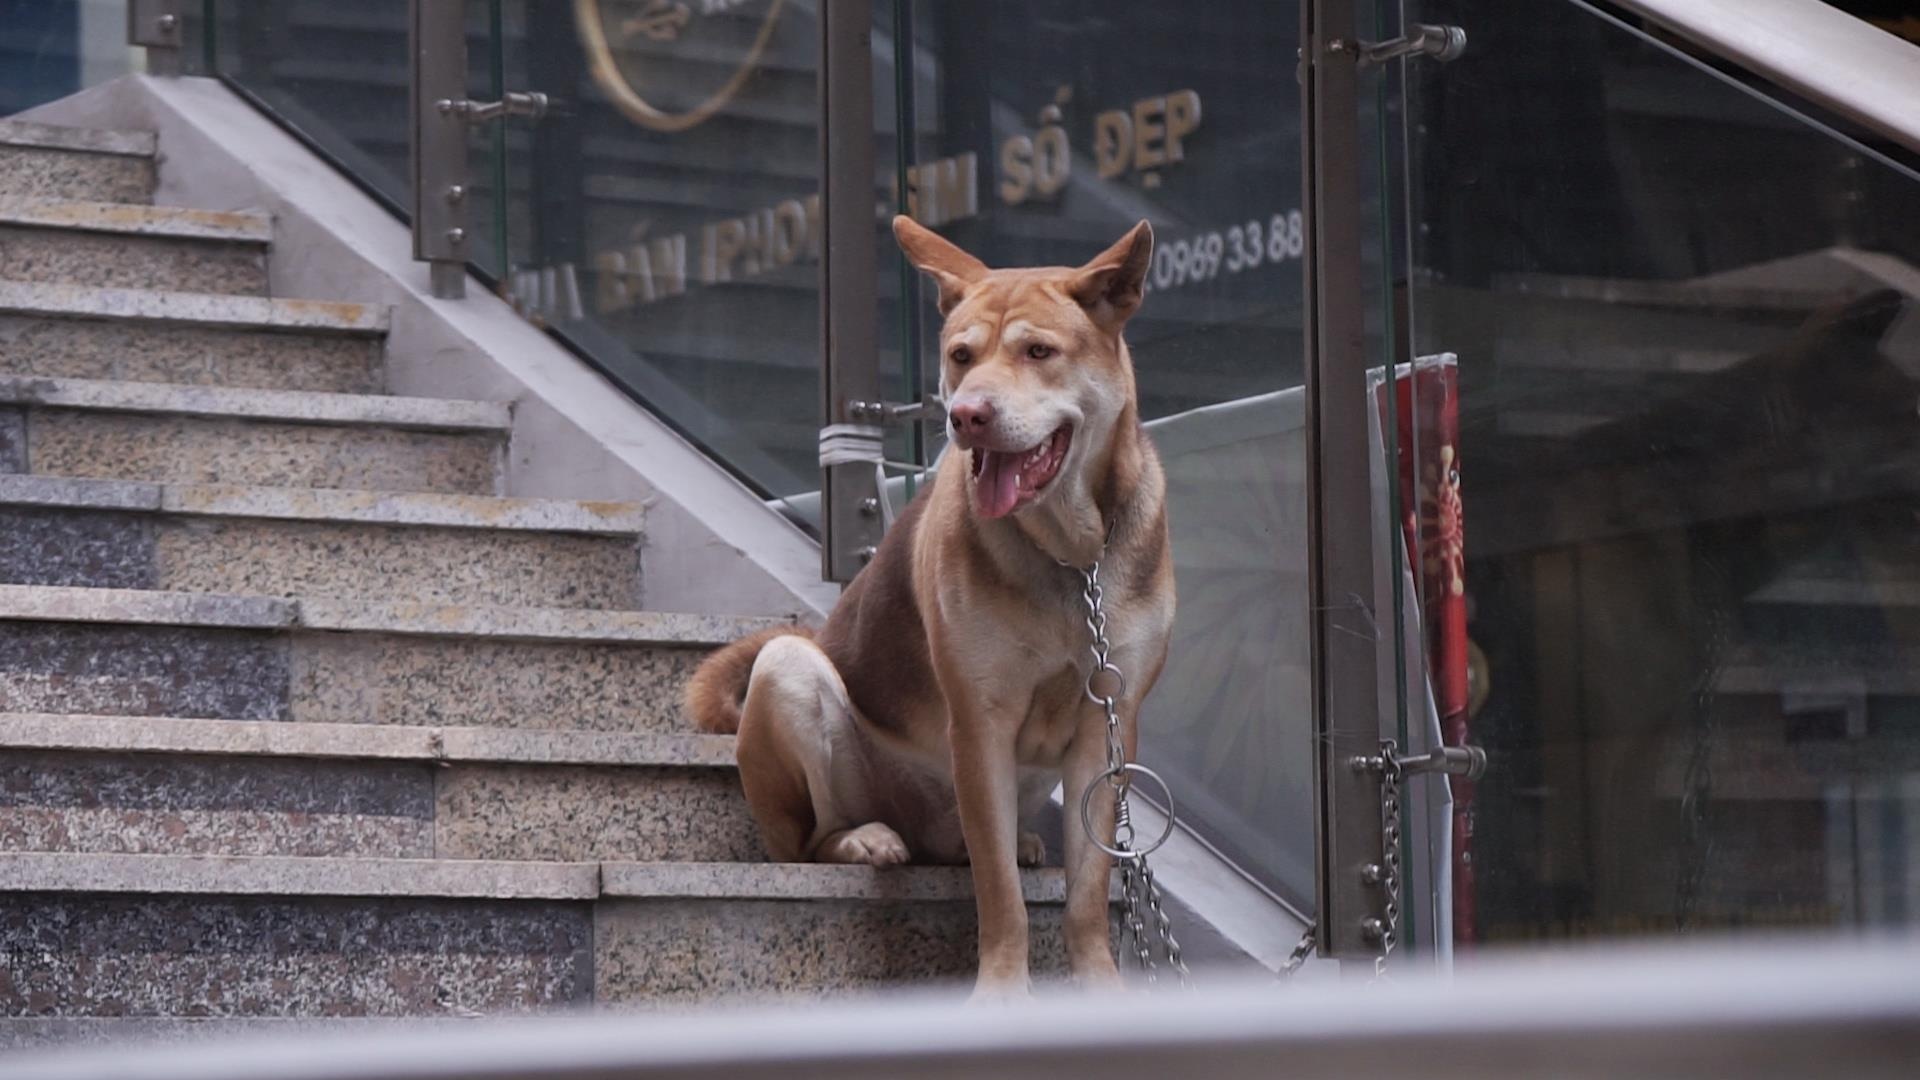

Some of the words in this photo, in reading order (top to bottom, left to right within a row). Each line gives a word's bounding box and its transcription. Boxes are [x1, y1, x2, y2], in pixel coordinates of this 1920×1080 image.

[1002, 85, 1071, 205] SỐ
[1094, 89, 1201, 188] ĐẸP
[1227, 219, 1265, 273] 33
